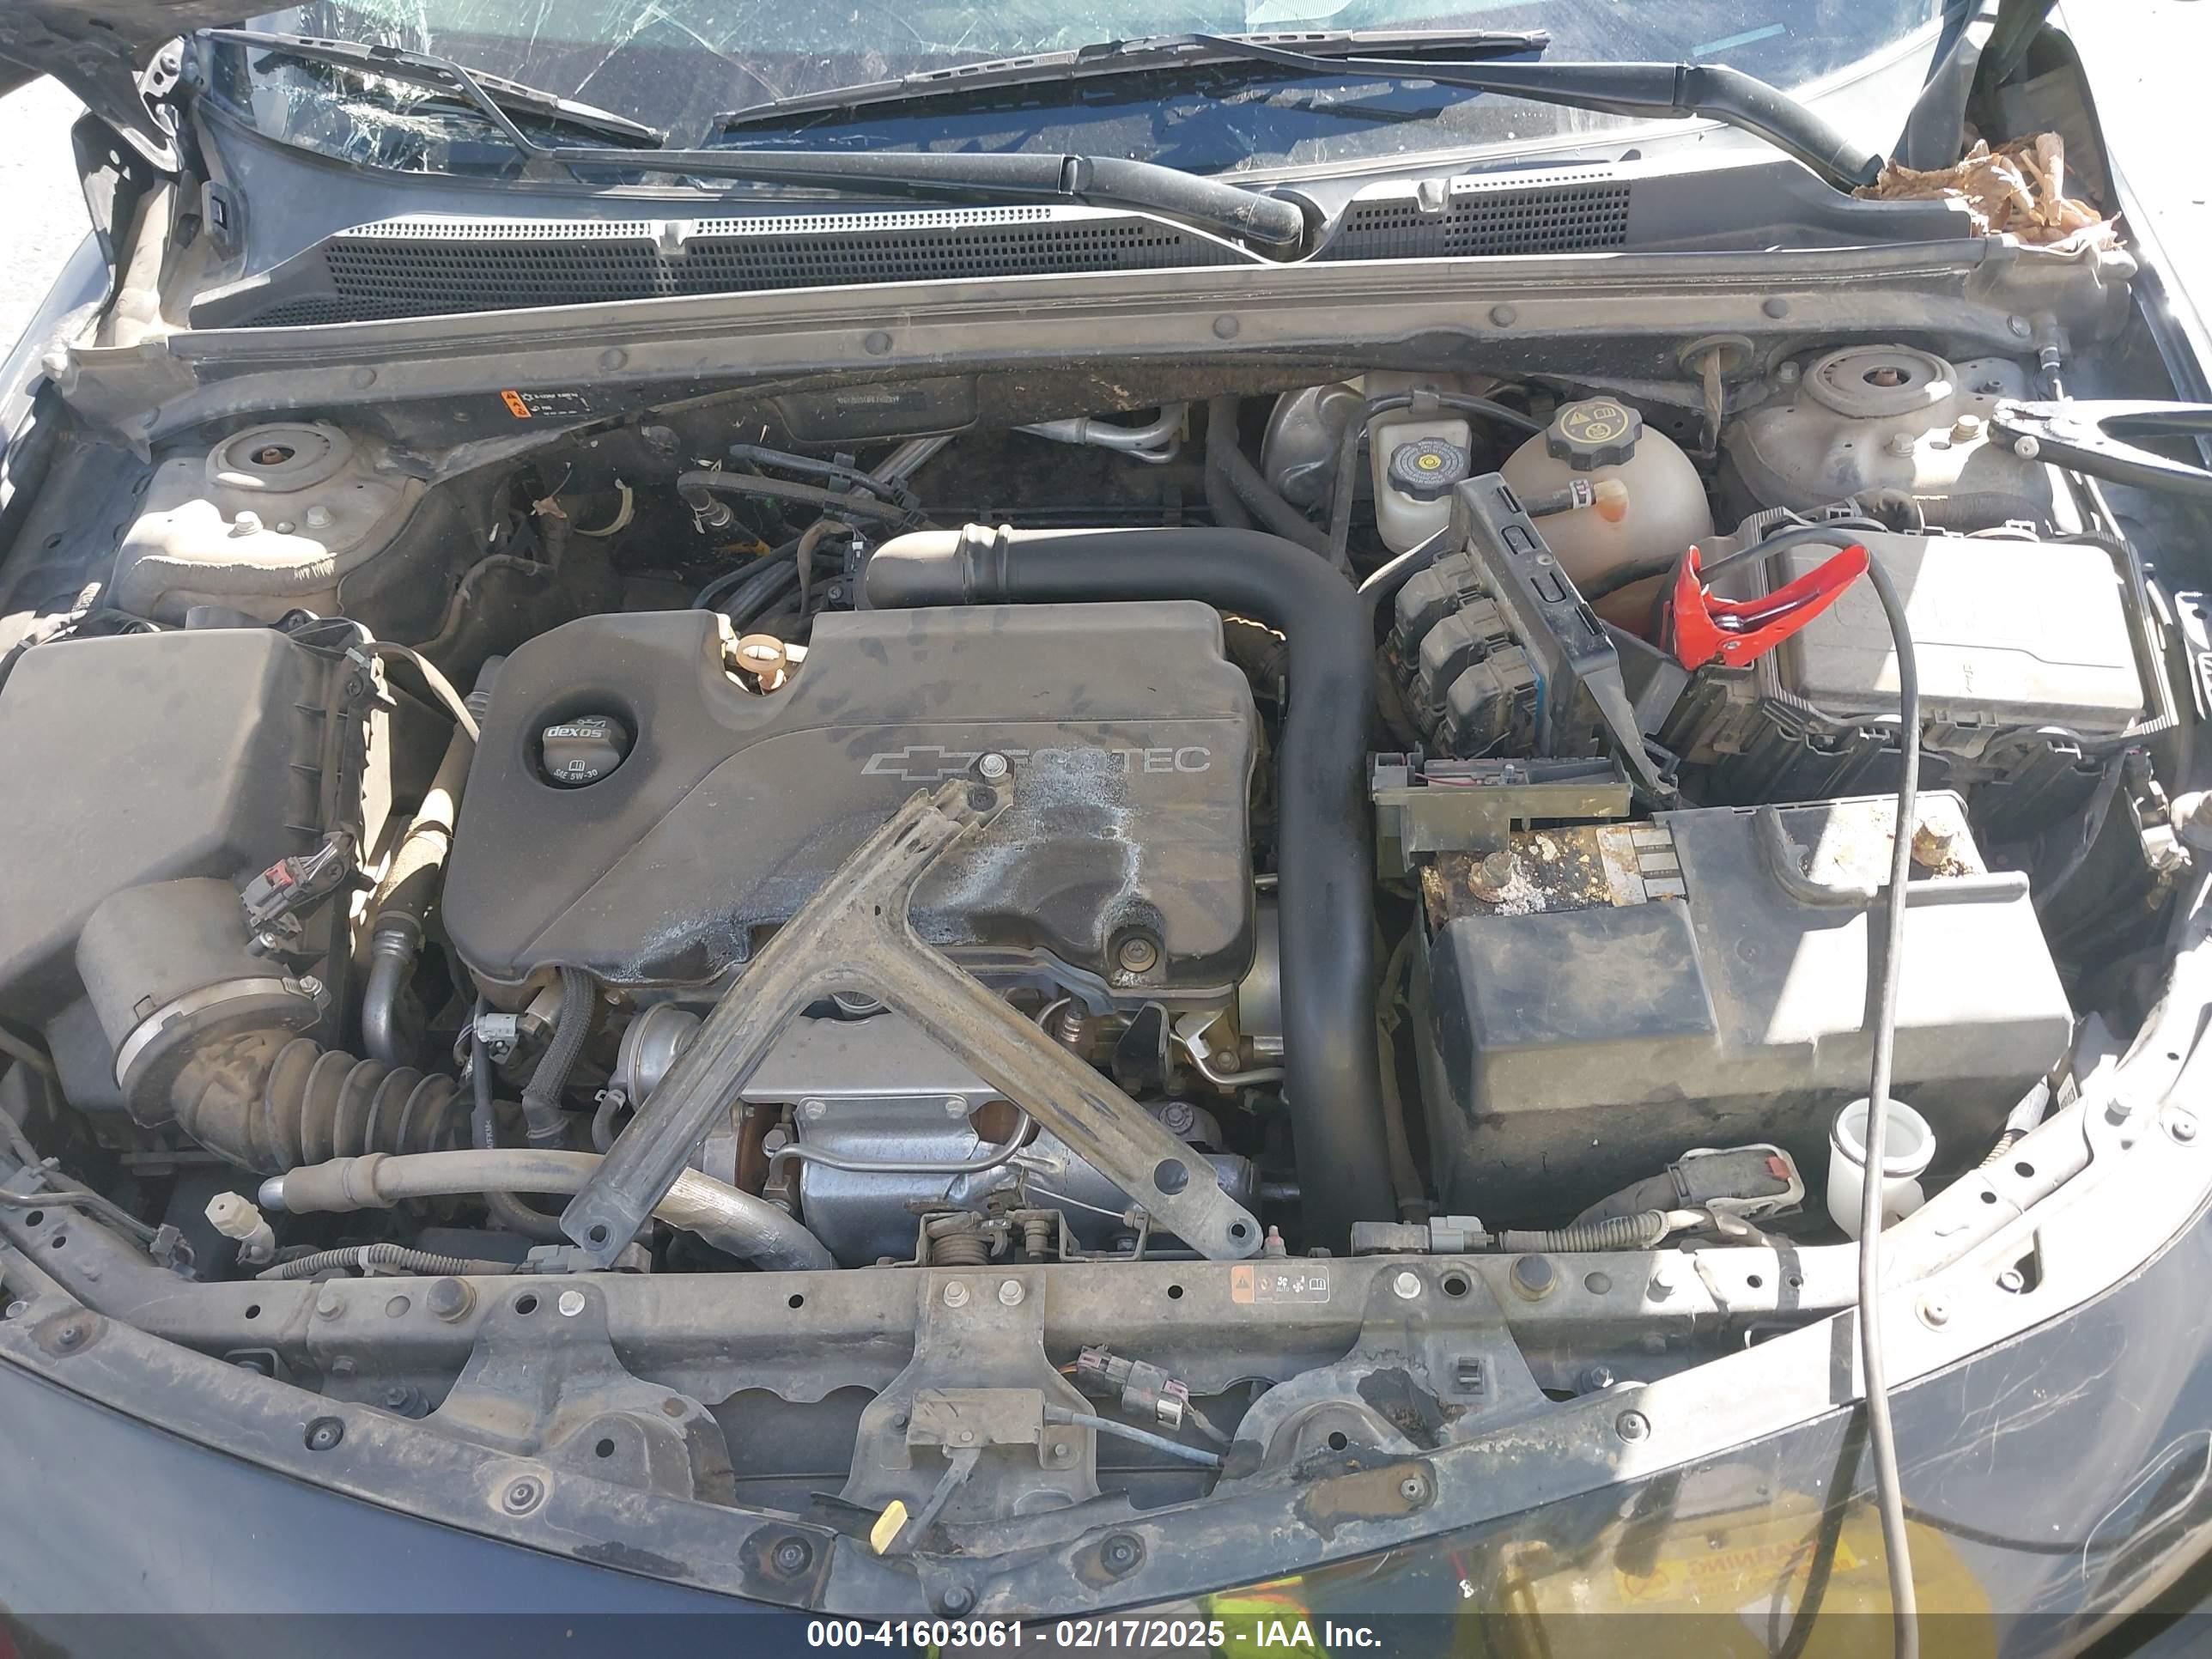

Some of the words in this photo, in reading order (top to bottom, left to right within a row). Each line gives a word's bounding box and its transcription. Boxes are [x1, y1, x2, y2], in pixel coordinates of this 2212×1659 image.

[547, 726, 604, 738] dexos
[553, 769, 568, 780] SAE
[569, 769, 599, 781] 5W-30
